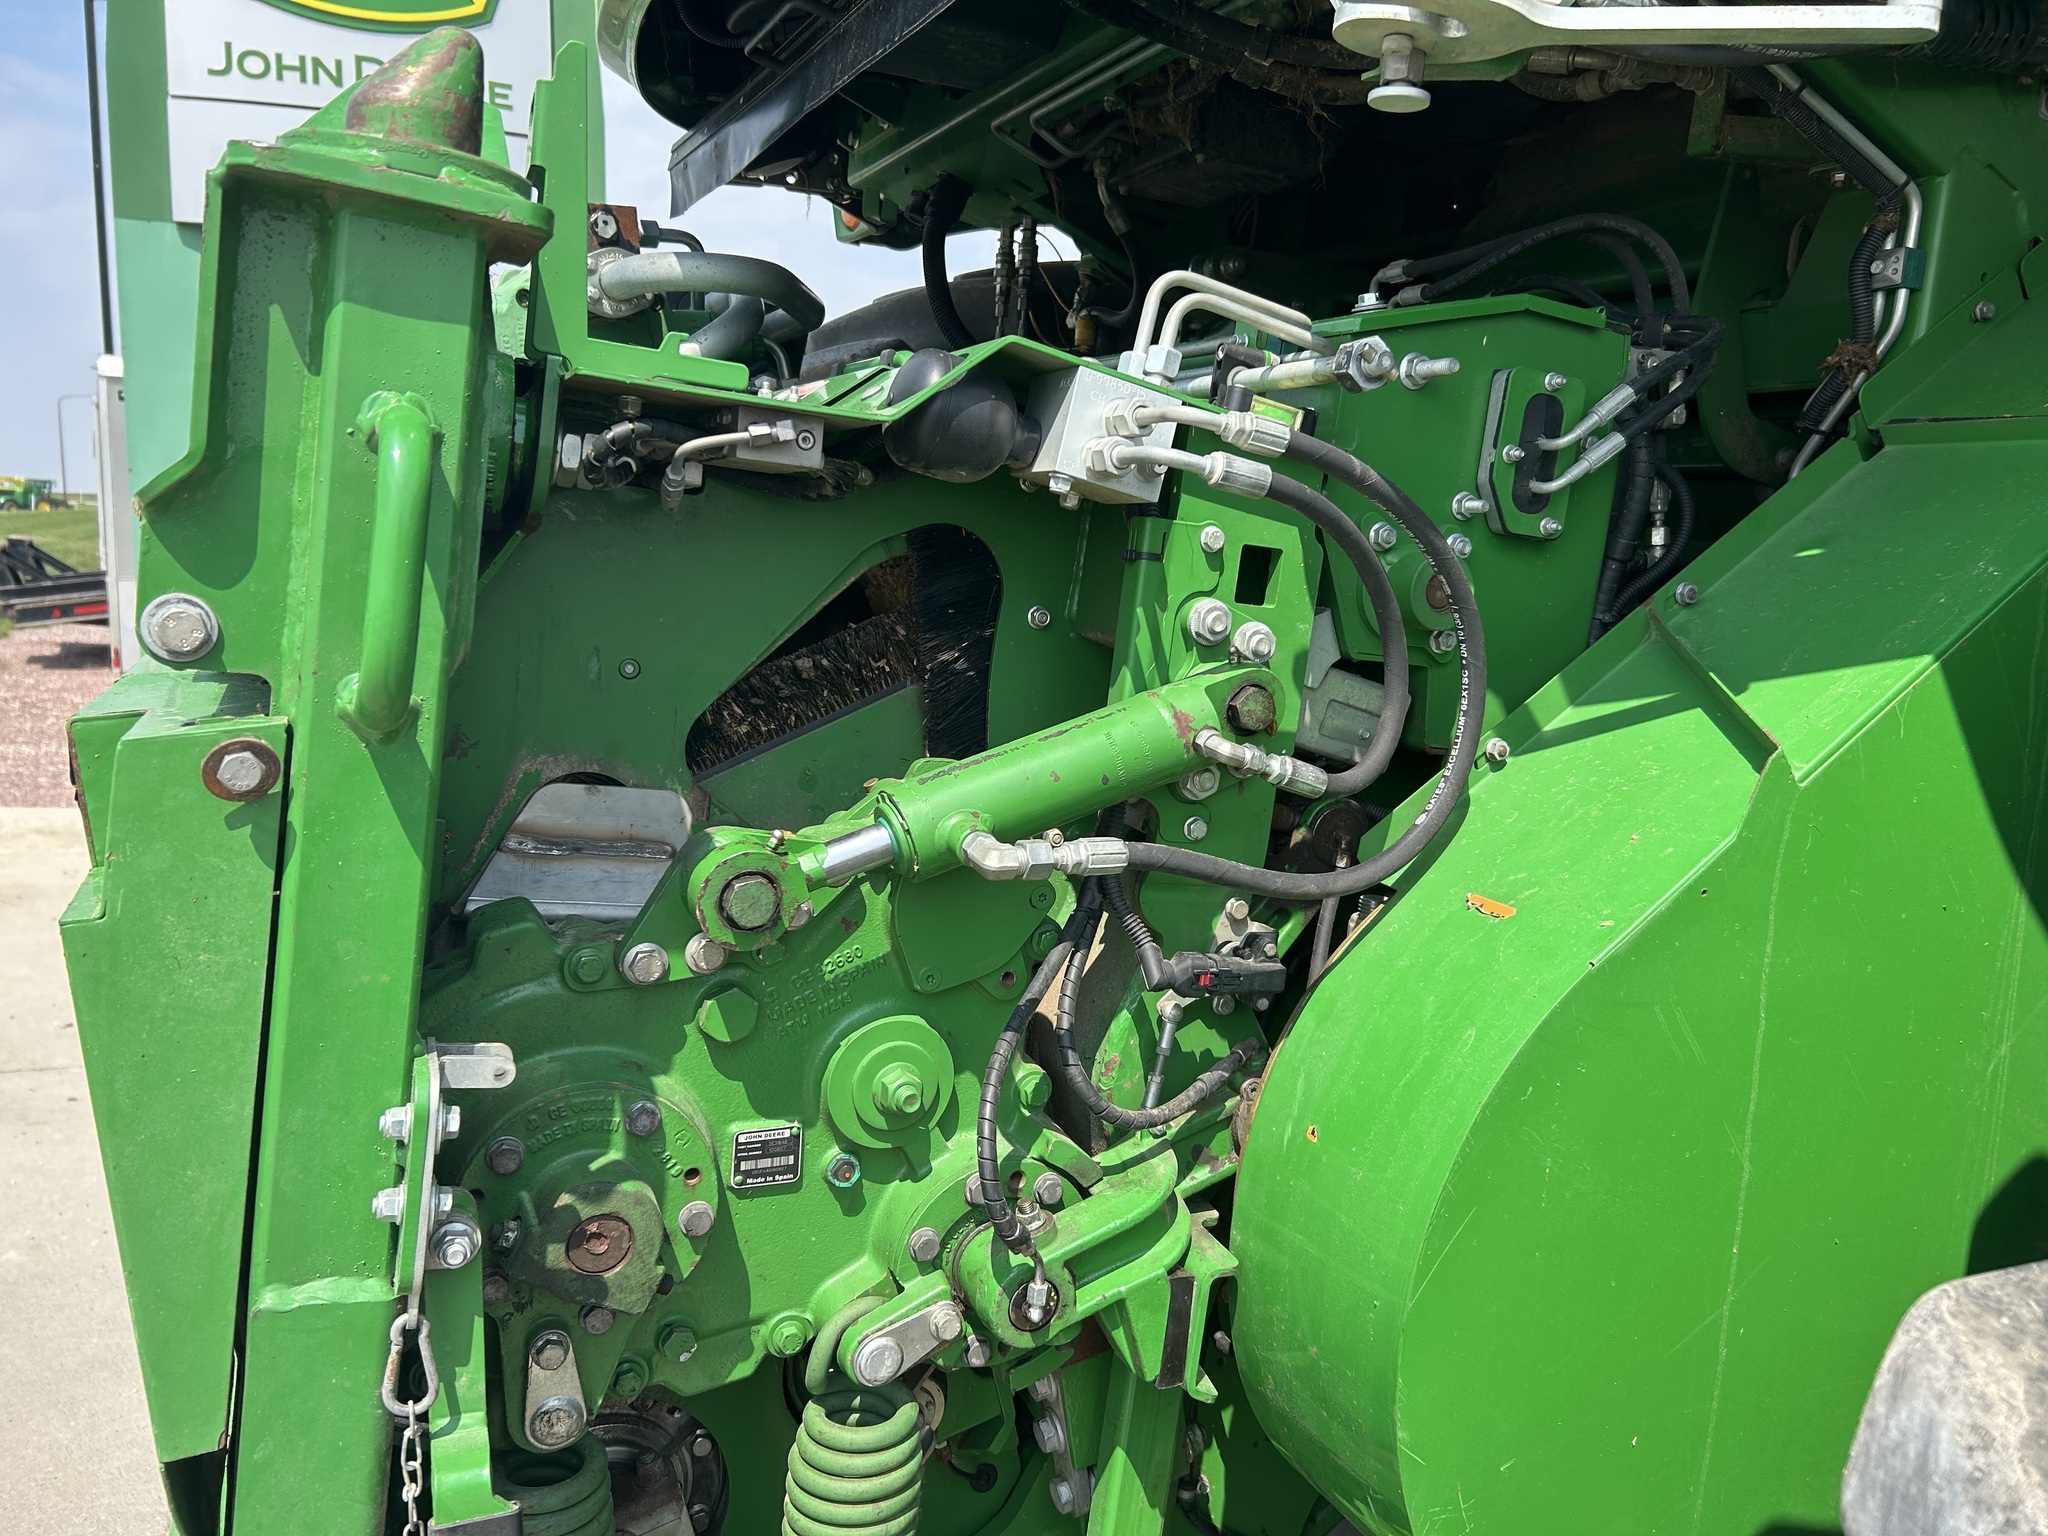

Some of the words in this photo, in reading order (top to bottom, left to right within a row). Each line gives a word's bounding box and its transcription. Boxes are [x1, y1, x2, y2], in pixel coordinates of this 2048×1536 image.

[207, 41, 343, 88] JOHN
[766, 989, 817, 1023] MADE
[818, 980, 838, 998] IN
[837, 954, 888, 988] SPAIN
[527, 1126, 564, 1154] MADE
[580, 1116, 622, 1133] SPAIN
[746, 1175, 765, 1184] Made
[766, 1174, 774, 1182] in
[774, 1173, 794, 1182] Spain
